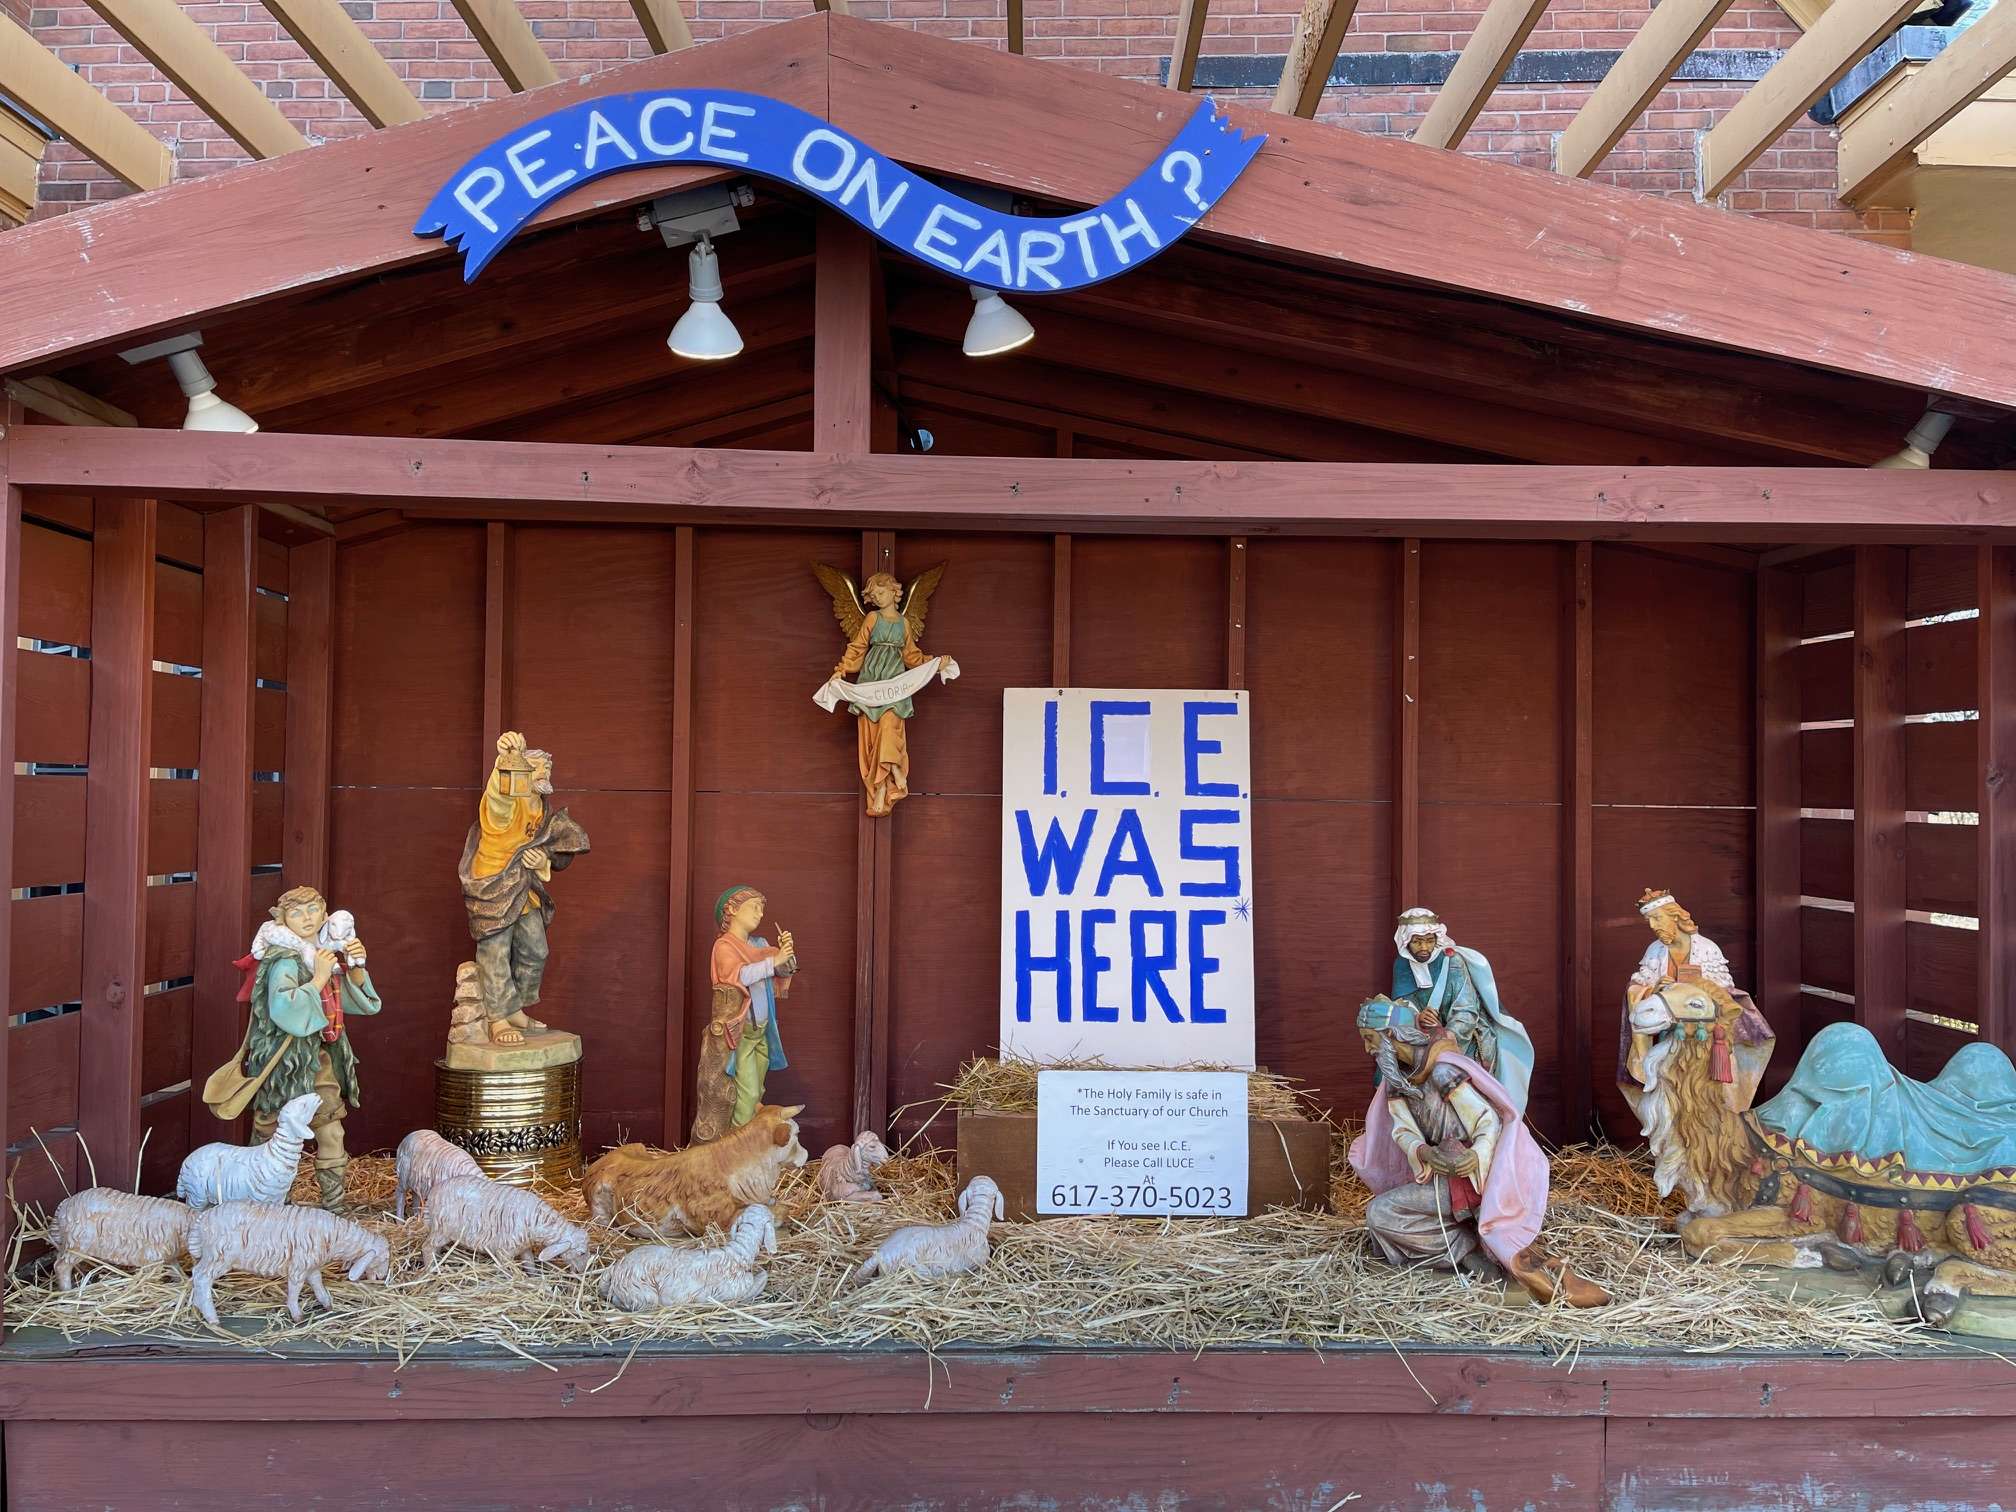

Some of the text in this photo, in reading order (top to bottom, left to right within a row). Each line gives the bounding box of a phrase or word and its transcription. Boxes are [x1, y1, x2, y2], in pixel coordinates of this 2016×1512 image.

[454, 97, 756, 233] PEACE
[792, 128, 909, 229] ON
[1015, 808, 1241, 897] WAS
[1107, 1088, 1132, 1101] Holy
[1135, 1088, 1171, 1101] Family
[1174, 1088, 1183, 1100] is
[1186, 1088, 1209, 1100] safe
[1212, 1089, 1222, 1100] in
[1070, 1105, 1228, 1118] The Sanctuary of our Church
[1107, 1140, 1191, 1151] If You see I.C.E.
[1104, 1157, 1194, 1168] Please Call LUCE
[1143, 1175, 1156, 1185] At
[1051, 1184, 1232, 1209] 617-370-5023
